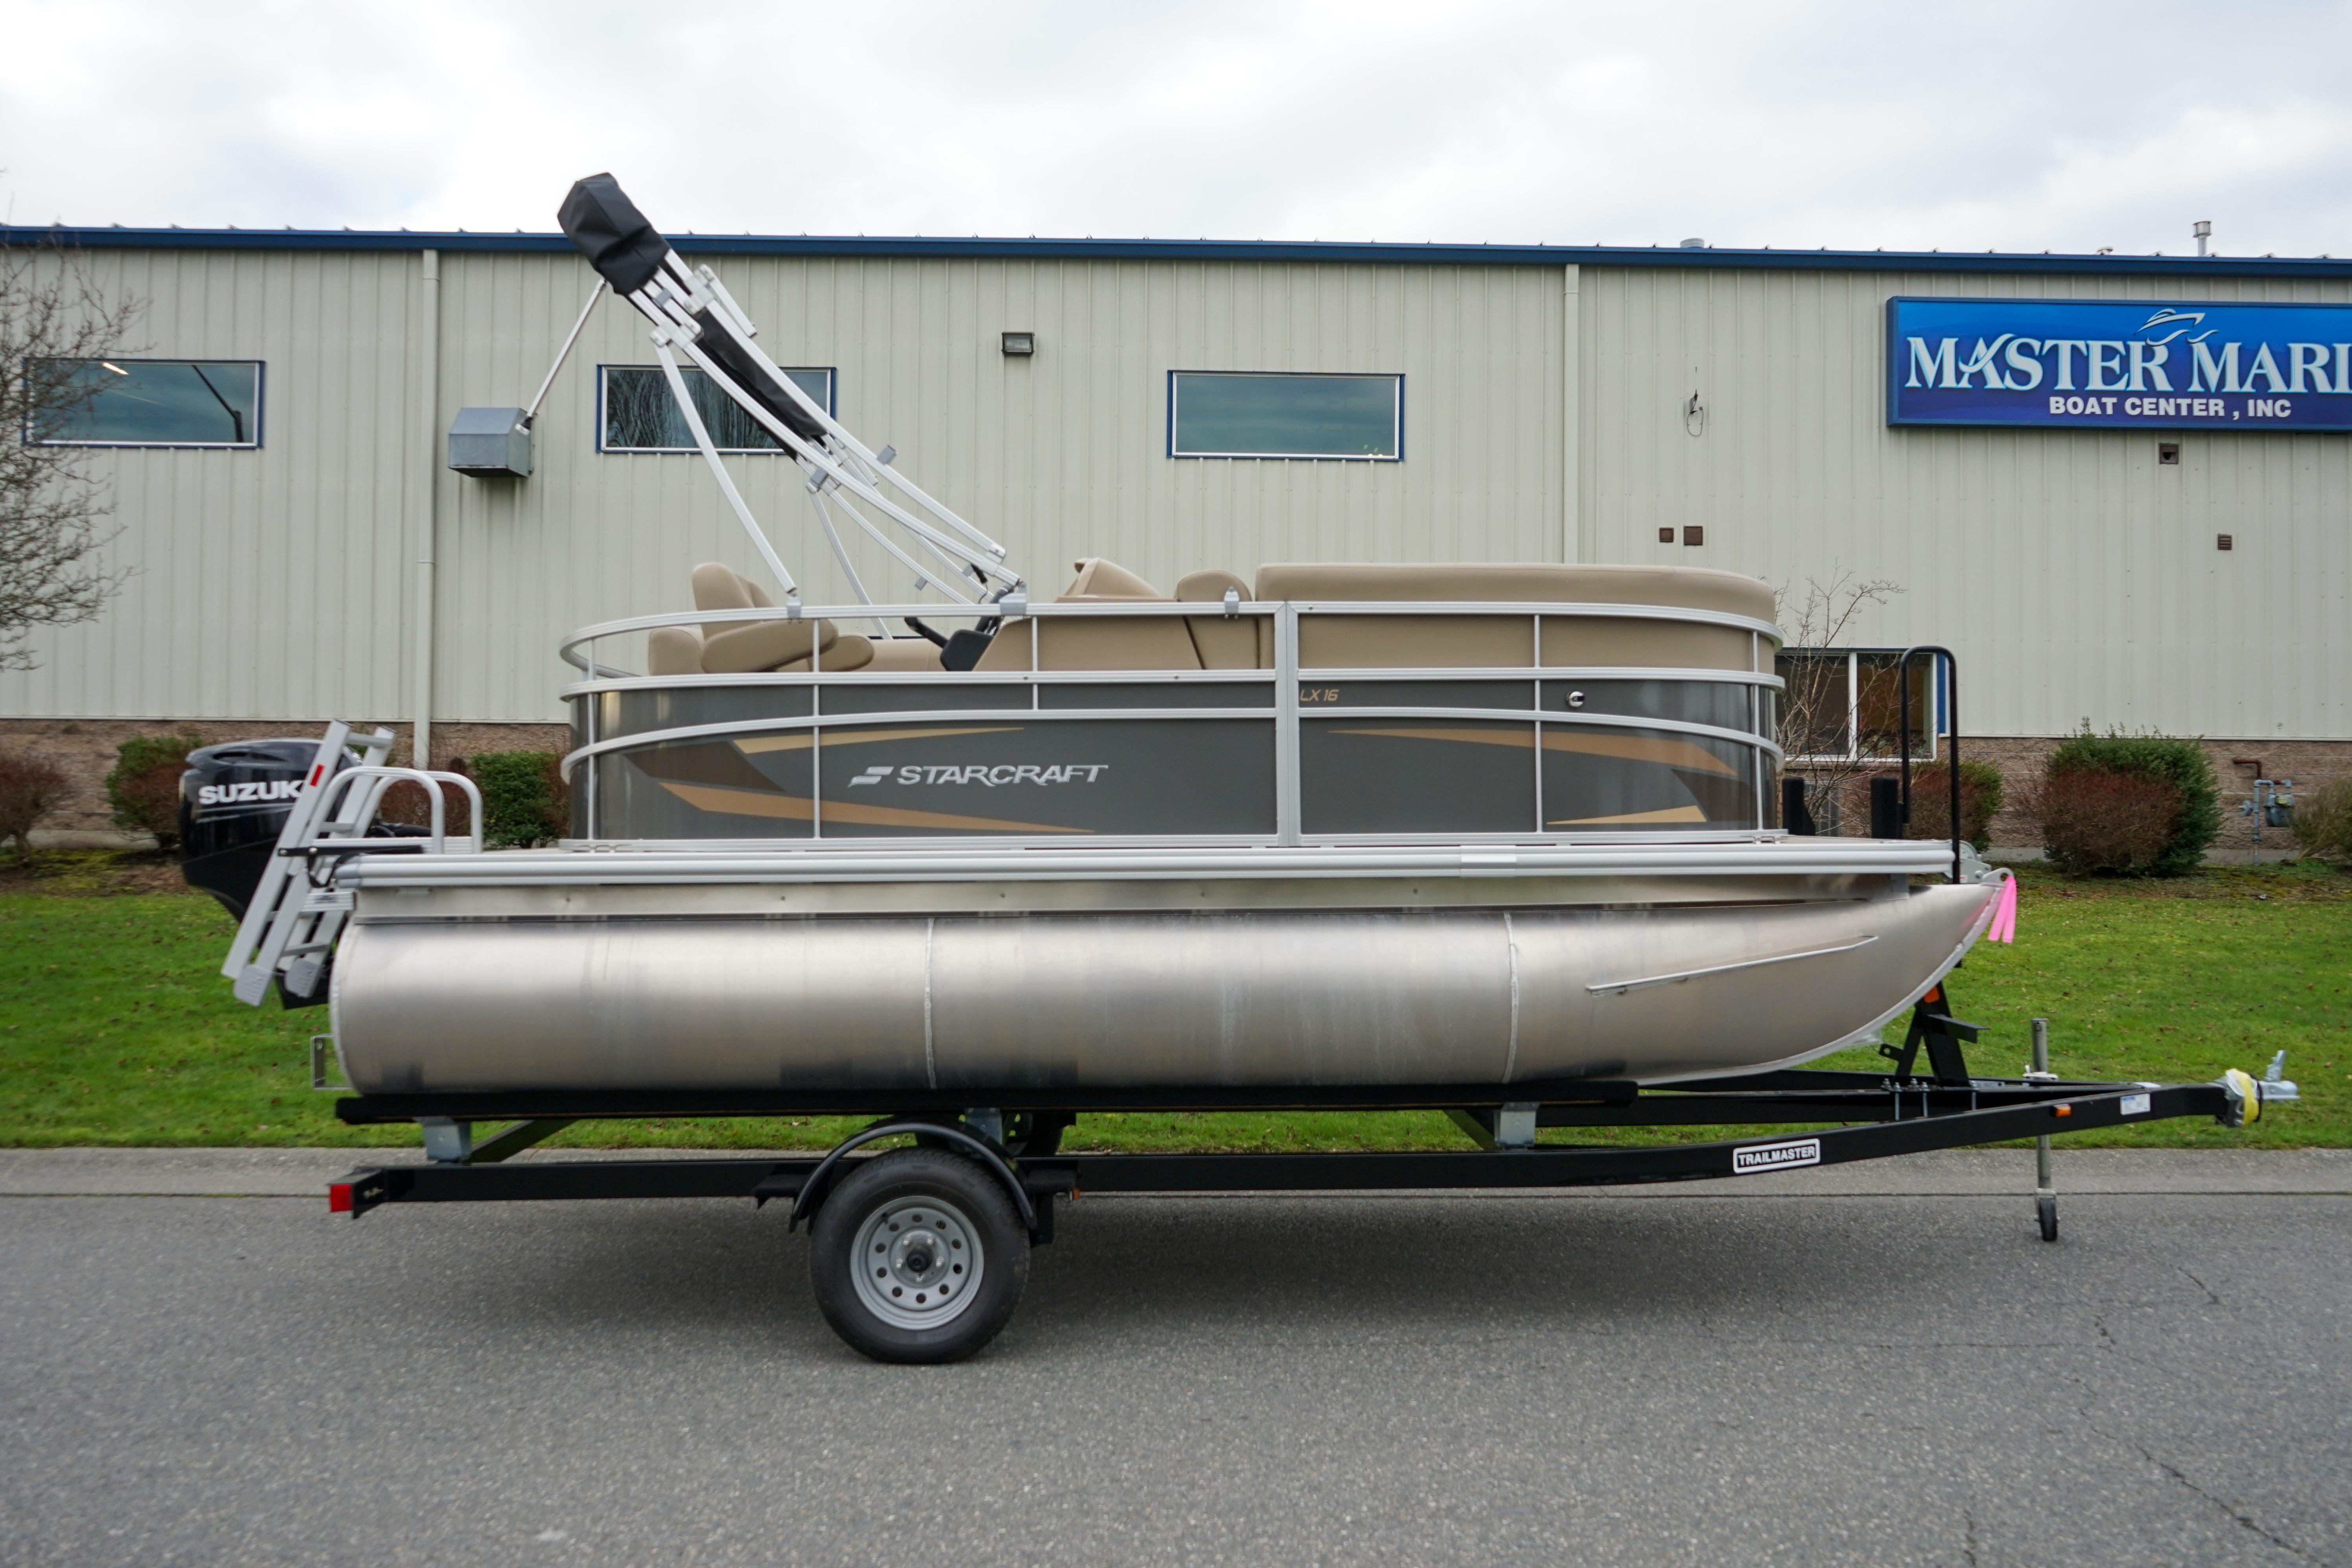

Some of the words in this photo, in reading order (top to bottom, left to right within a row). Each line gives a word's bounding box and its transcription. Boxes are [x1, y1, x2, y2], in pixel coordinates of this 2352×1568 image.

[1905, 333, 2174, 391] MASTER
[2049, 397, 2118, 415] BOAT
[2248, 399, 2292, 418] INC
[1300, 689, 1321, 701] LX
[1323, 689, 1339, 701] 16
[897, 765, 1109, 786] STARCRAFT
[199, 780, 304, 804] SUZUK
[1738, 1146, 1815, 1166] TRAILMASTER
